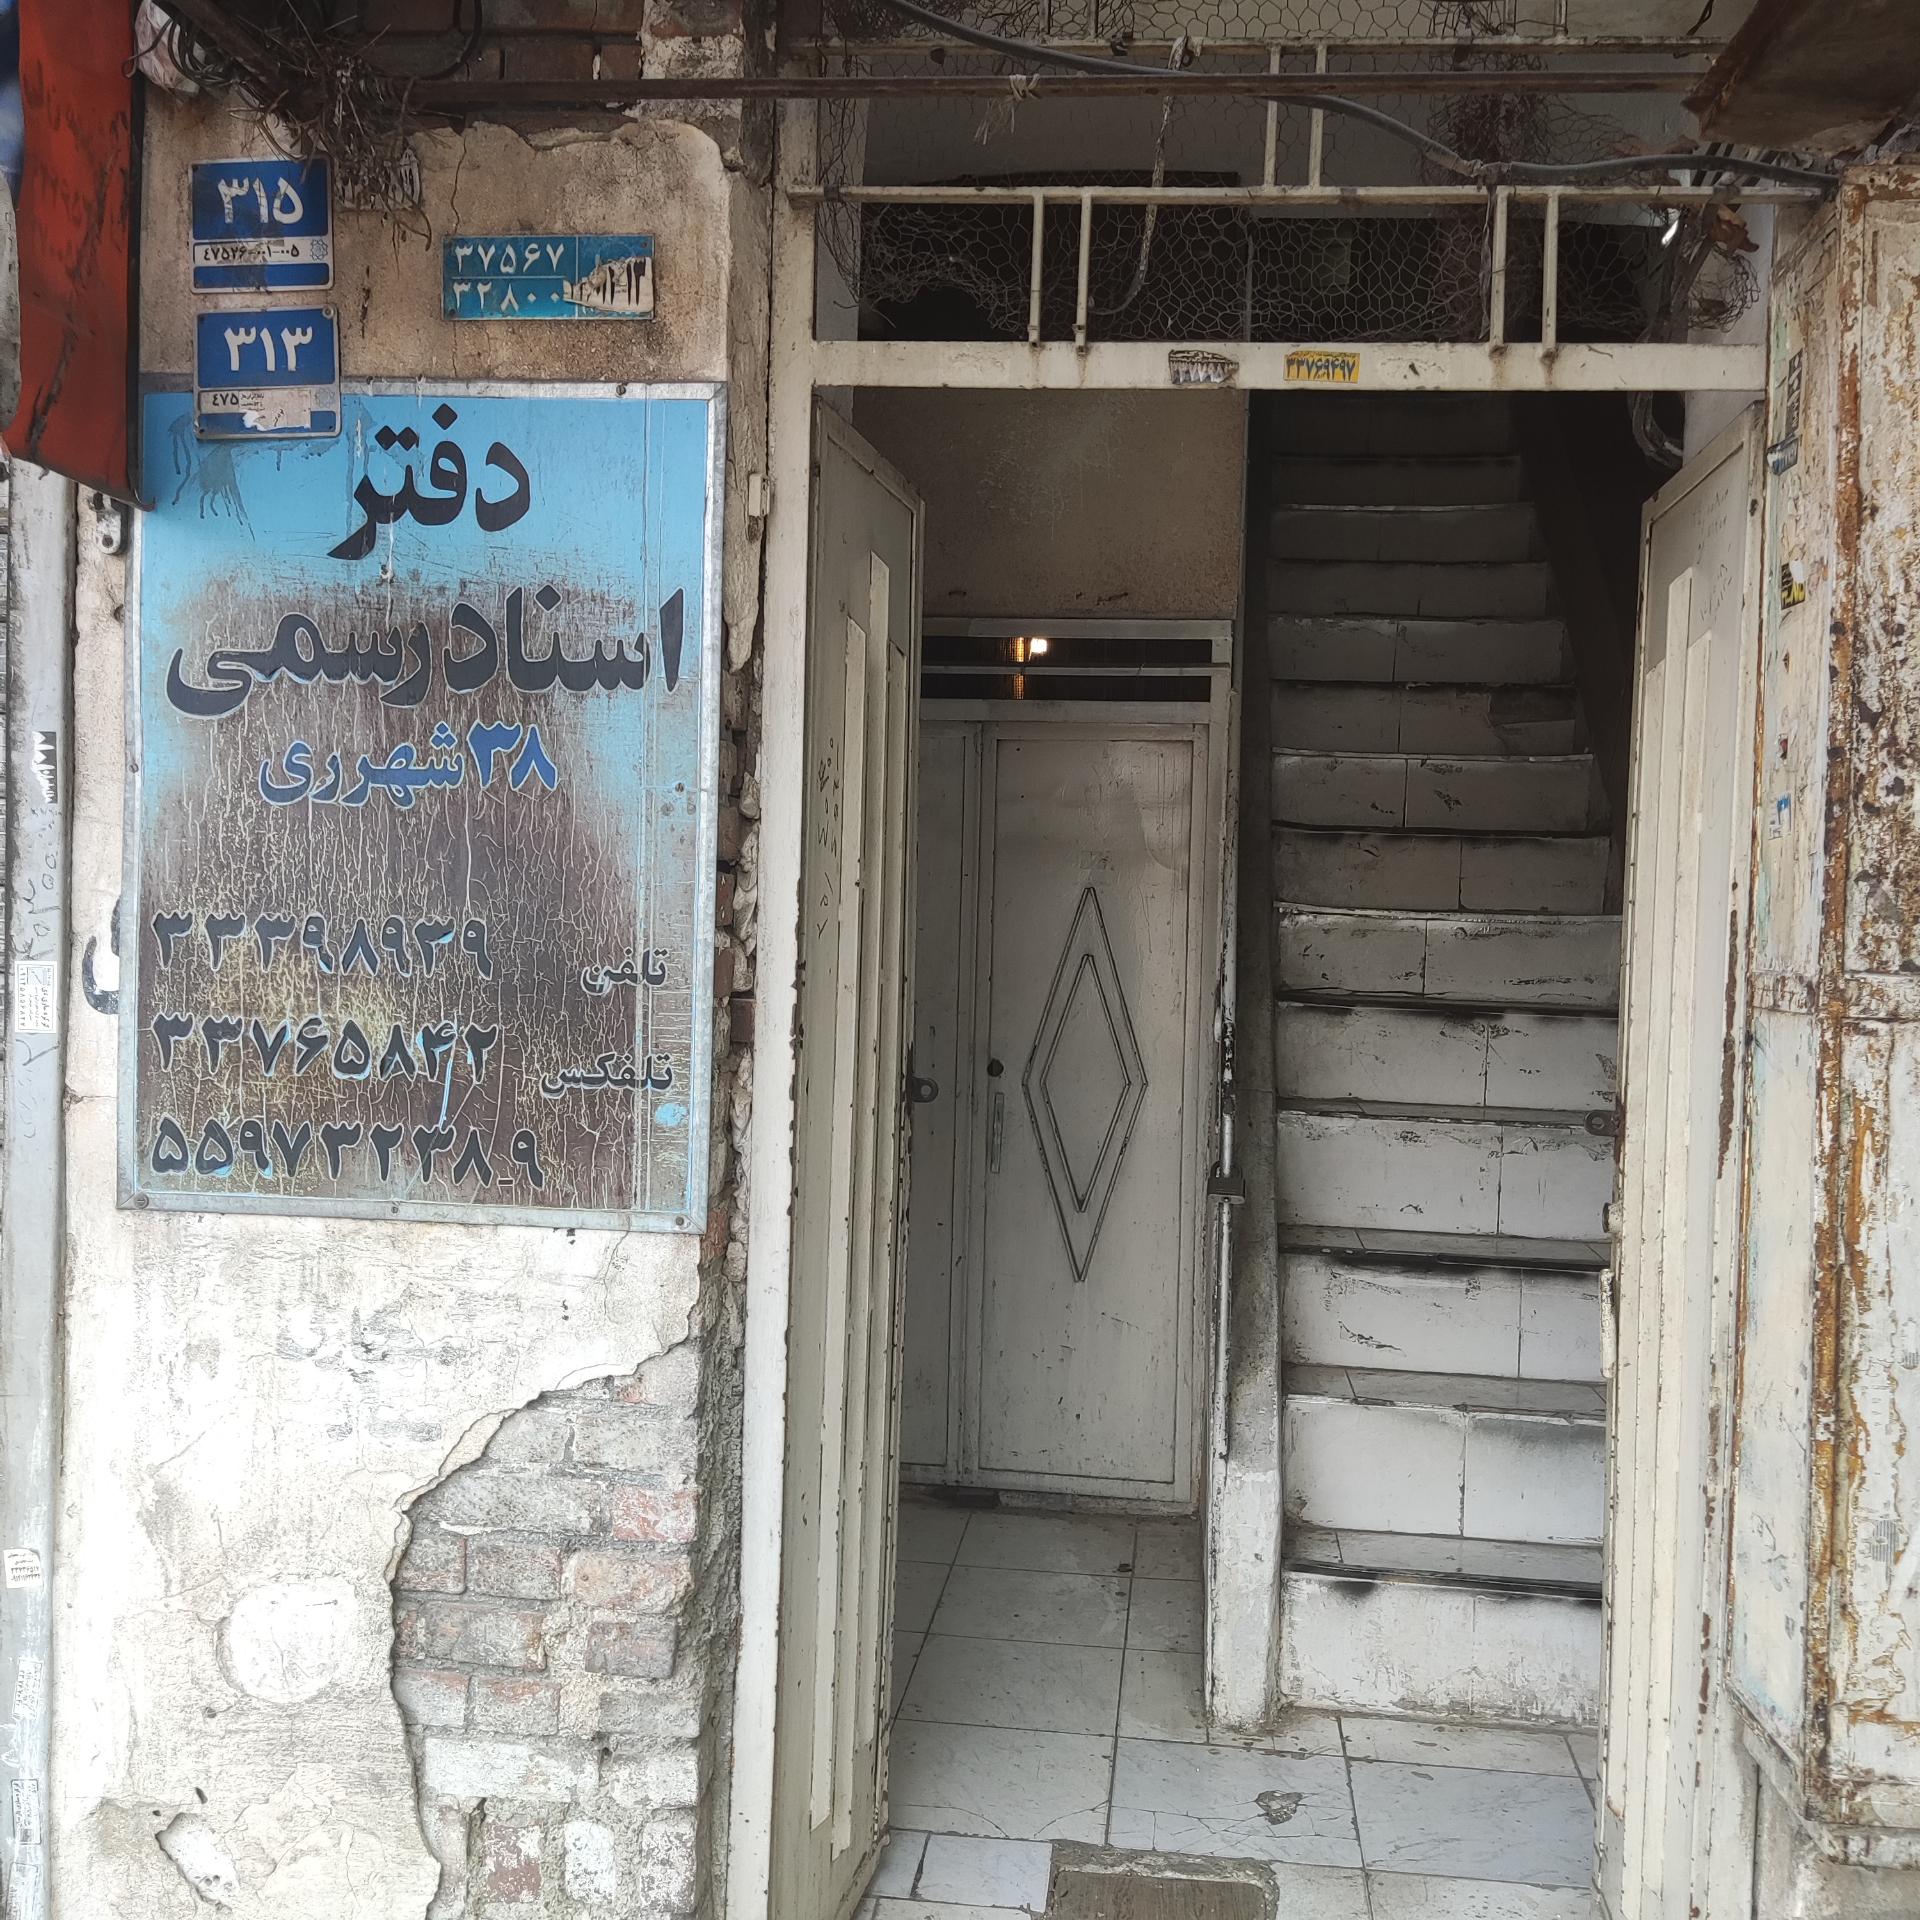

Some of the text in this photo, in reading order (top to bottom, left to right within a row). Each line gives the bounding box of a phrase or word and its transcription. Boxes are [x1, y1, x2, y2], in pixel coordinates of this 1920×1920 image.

[218, 177, 304, 224] ۳۱۵
[452, 281, 560, 313] ۳۲۸۰۰
[454, 243, 565, 274] ۳۷۵۶۷
[224, 326, 313, 372] ۳۱۳
[328, 403, 531, 560] دفتر
[166, 583, 685, 718] اسناد رسمی
[259, 720, 558, 808] ۳۸ شهر ری
[152, 911, 669, 996] تلفن ۳۳۳۹۸۹۳۹
[152, 1012, 674, 1100] تلفکس ۳۳۷۶۵۸۴۲
